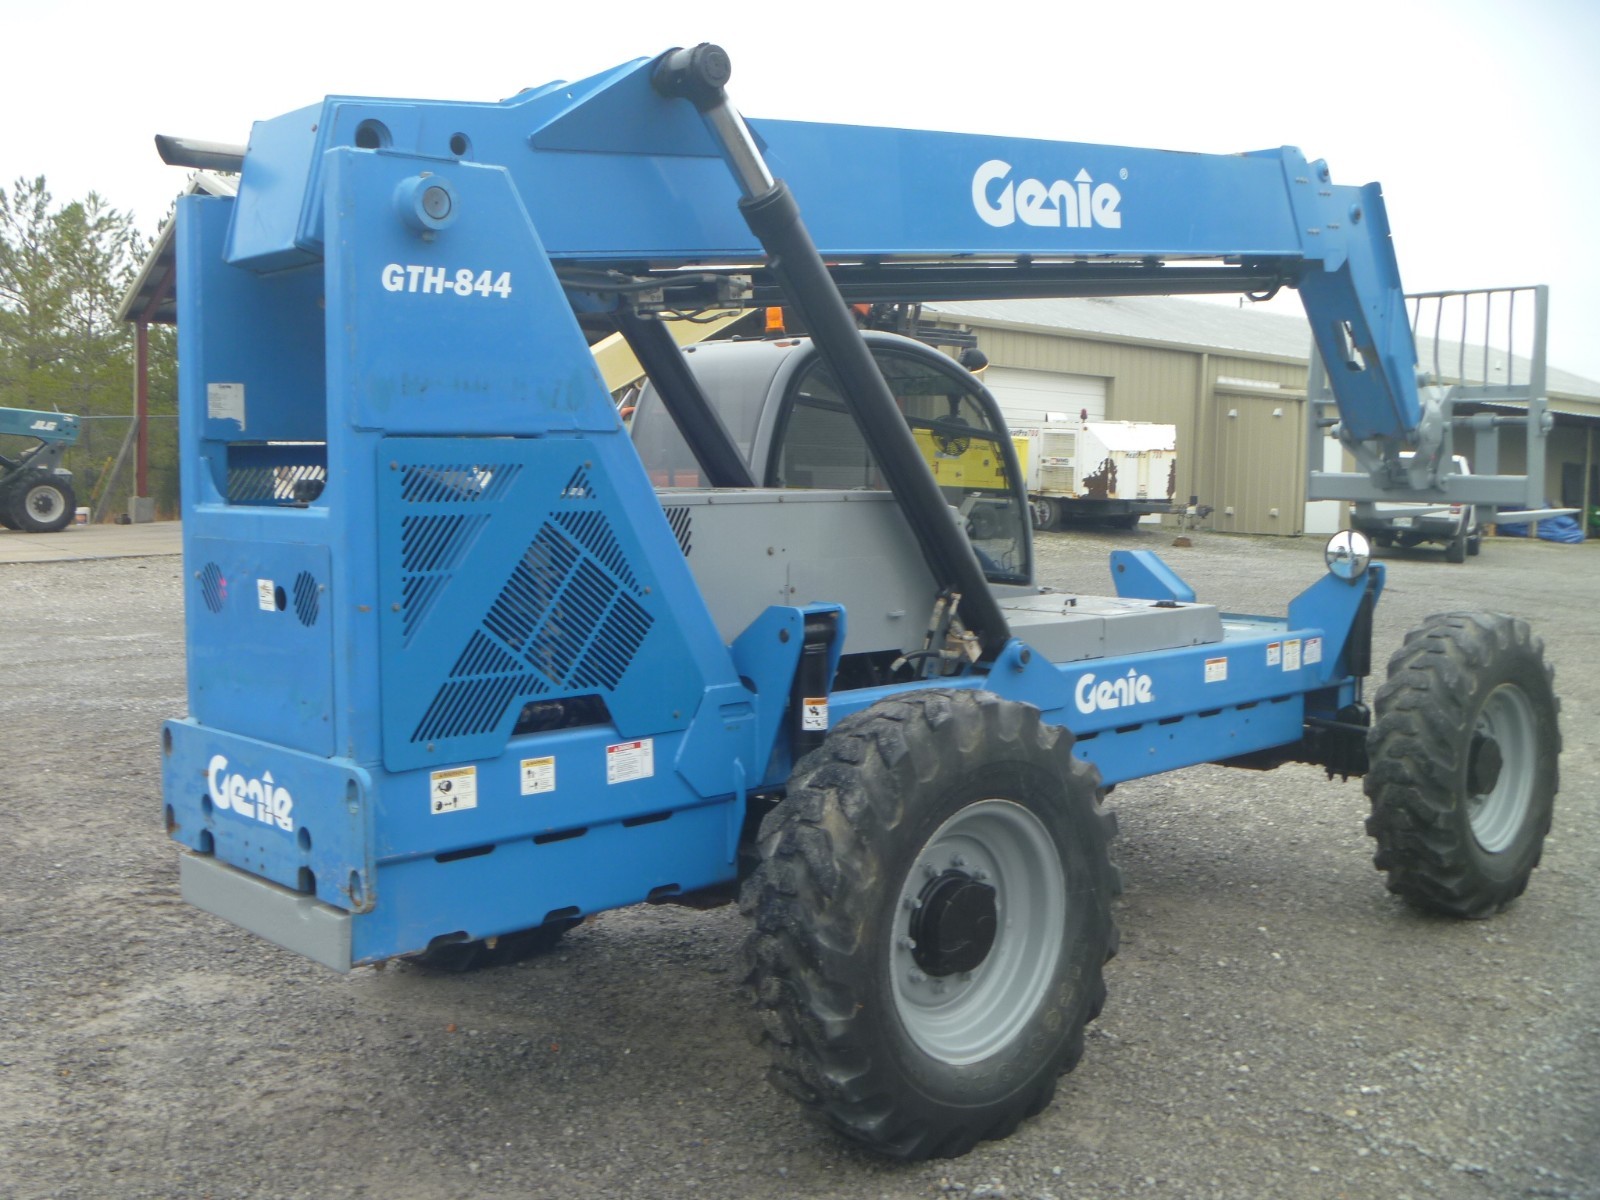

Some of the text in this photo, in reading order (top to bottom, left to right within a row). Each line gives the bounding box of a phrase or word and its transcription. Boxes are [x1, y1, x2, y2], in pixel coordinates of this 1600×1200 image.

[972, 159, 1121, 228] Genie
[381, 263, 512, 298] GTH-844
[1075, 668, 1152, 714] Genie
[208, 754, 293, 832] Genie
